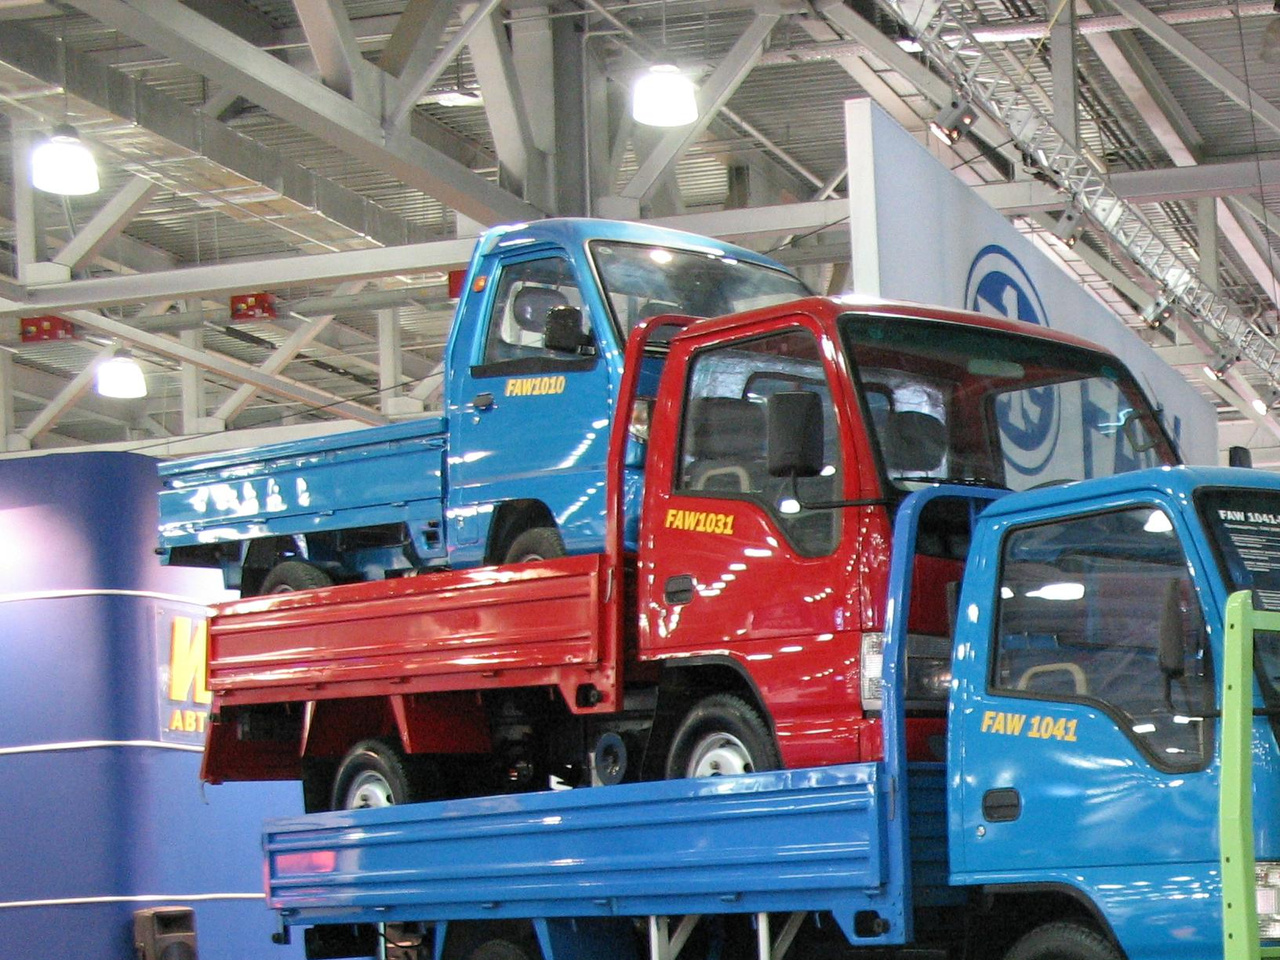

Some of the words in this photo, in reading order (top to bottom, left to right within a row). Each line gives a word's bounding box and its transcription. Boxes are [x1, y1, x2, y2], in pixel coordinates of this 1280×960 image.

[505, 375, 566, 397] FAW1010
[665, 508, 734, 535] FAW1031
[1218, 509, 1245, 522] FAW
[981, 710, 1026, 736] FAW
[1028, 715, 1077, 742] 1041
